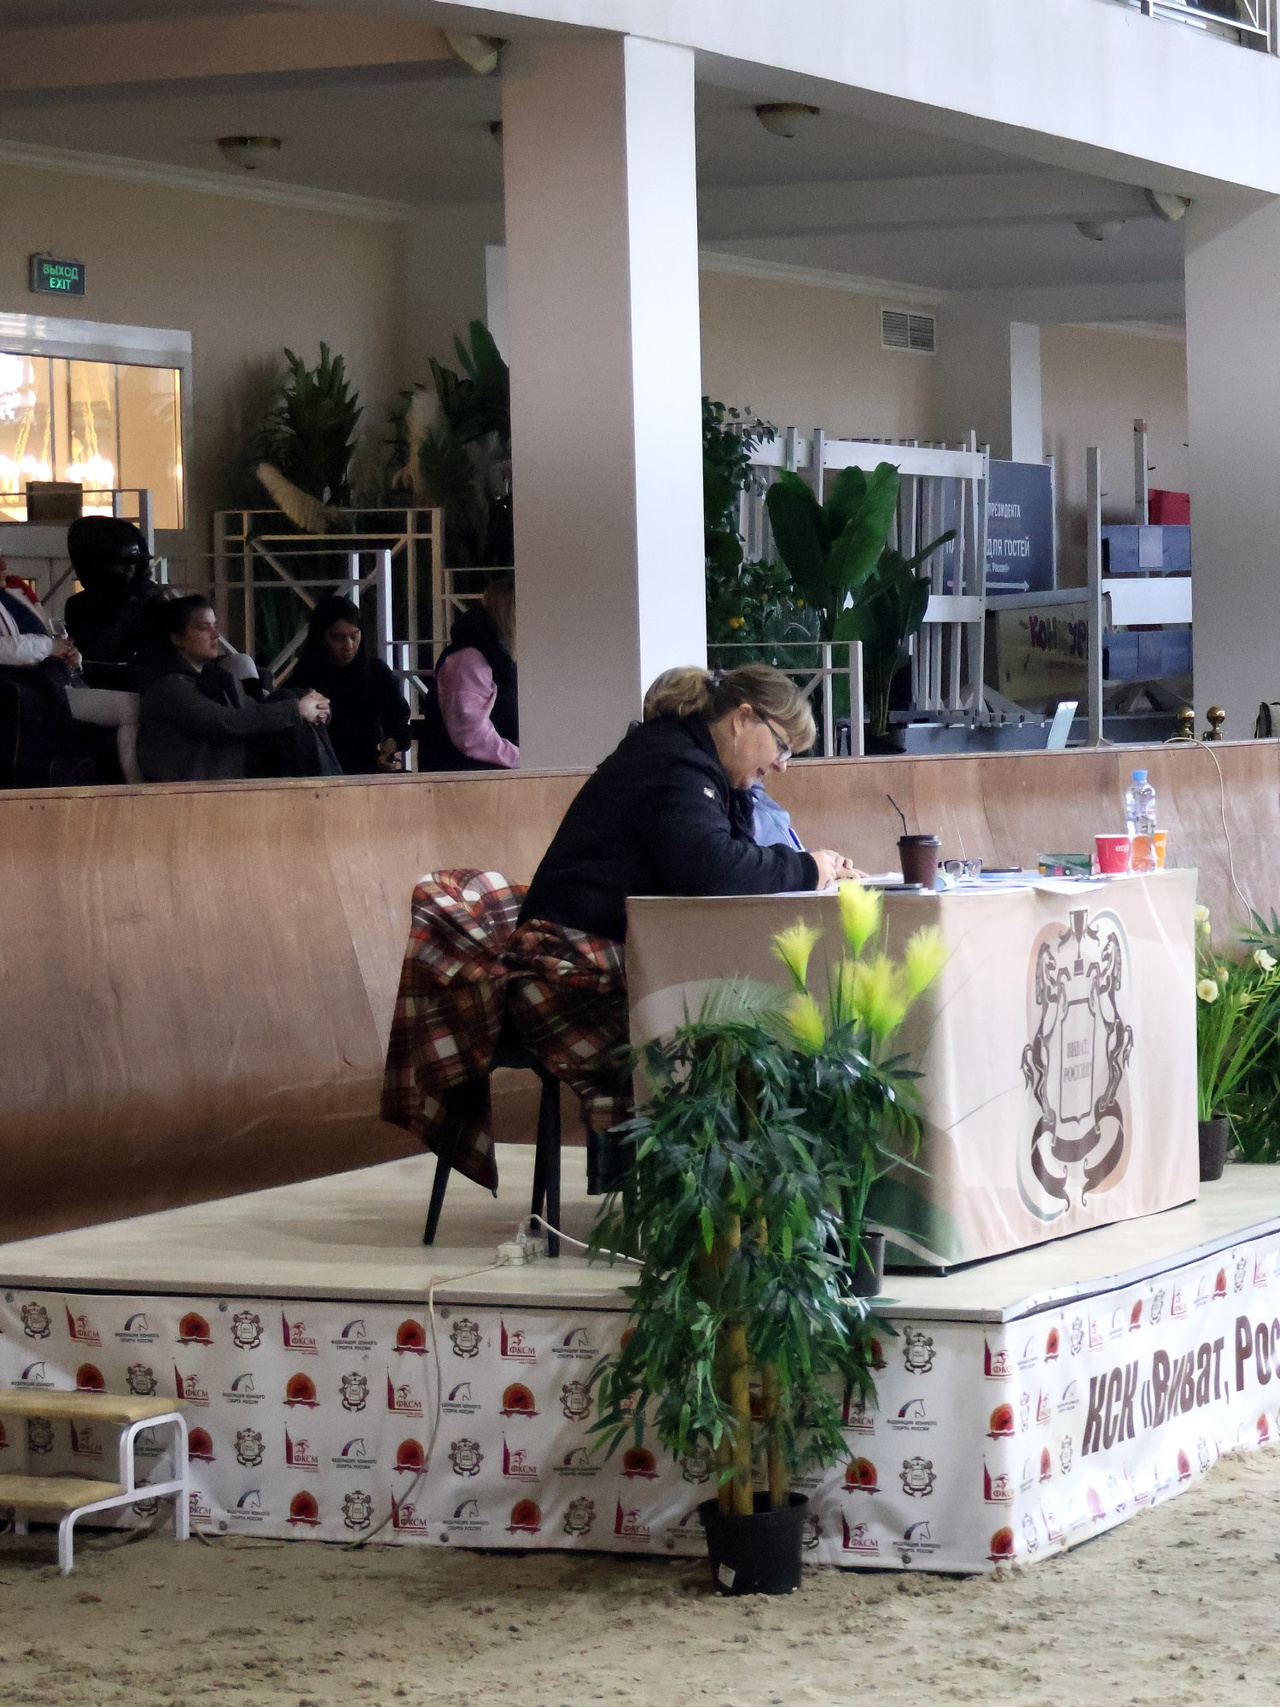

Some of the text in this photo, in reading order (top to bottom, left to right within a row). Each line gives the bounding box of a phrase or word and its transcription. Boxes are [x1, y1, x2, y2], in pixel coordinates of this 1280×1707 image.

[43, 263, 79, 280] ВЫХОД
[50, 277, 71, 289] EXIT
[1004, 536, 1030, 557] ГОСТЕЙ
[291, 1336, 316, 1345] ФКСМ
[509, 1346, 536, 1355] ФКСМ
[185, 1389, 209, 1398] ФКСМ
[396, 1401, 422, 1409] ФКСМ
[1081, 1360, 1139, 1457] КСК
[294, 1455, 319, 1463] ФКСМ
[511, 1465, 537, 1474] ФКСМ
[400, 1519, 427, 1527] ФКСМ
[851, 1538, 878, 1548] ФКСМ
